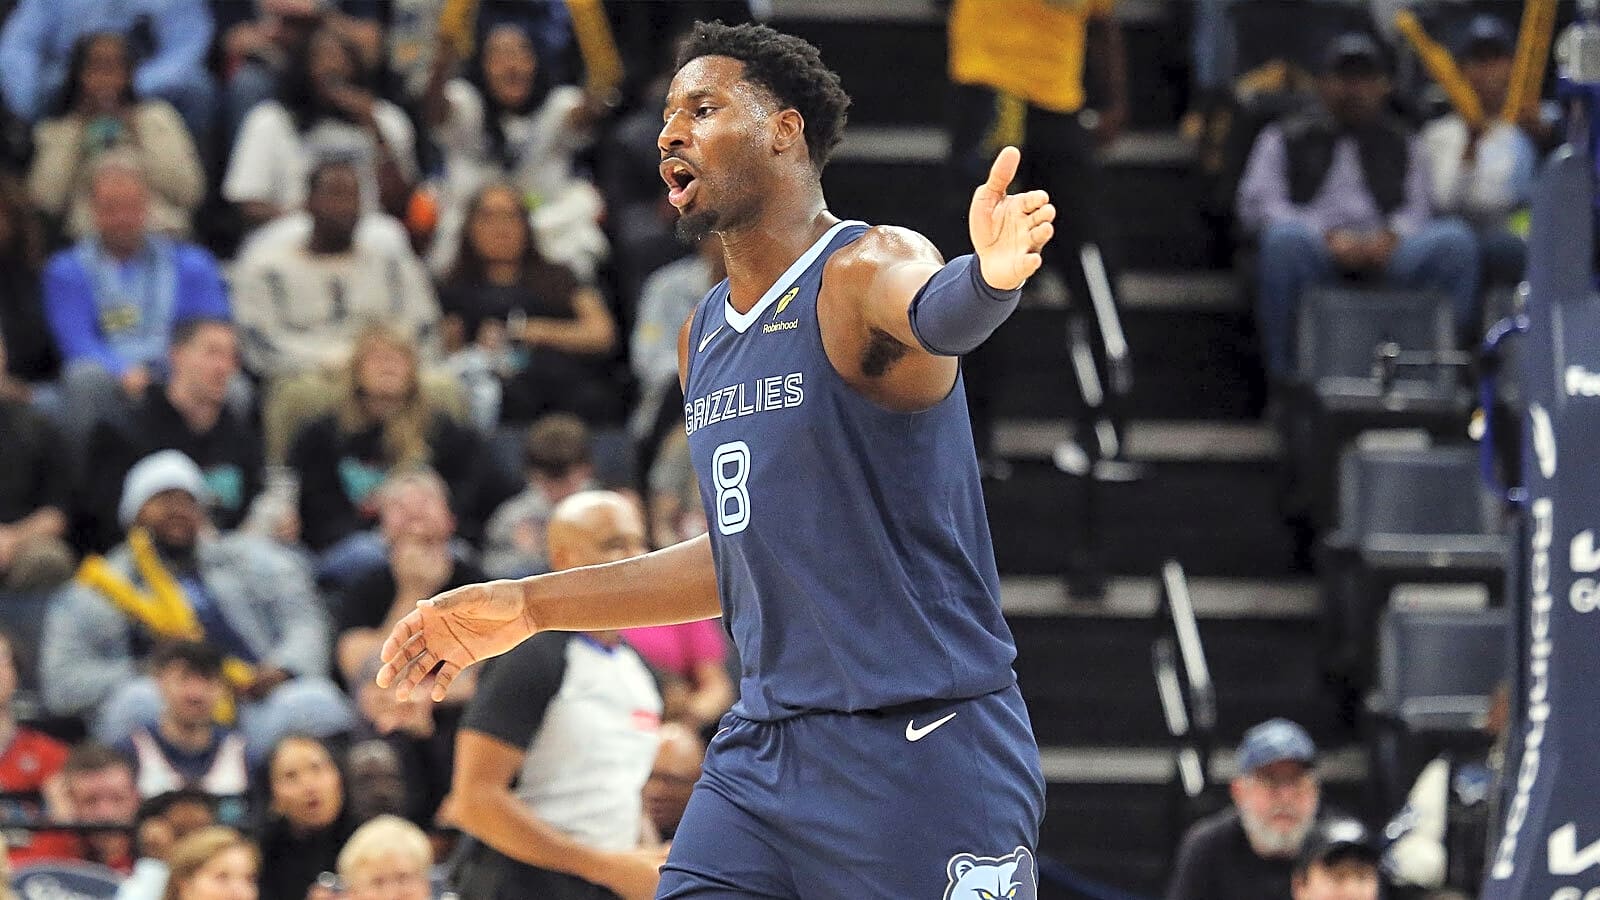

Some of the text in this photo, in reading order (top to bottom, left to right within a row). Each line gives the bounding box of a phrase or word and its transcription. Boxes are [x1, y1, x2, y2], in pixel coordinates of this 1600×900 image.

[762, 318, 799, 334] Robinhood
[684, 372, 804, 437] GRIZZLIES
[712, 440, 751, 536] 8
